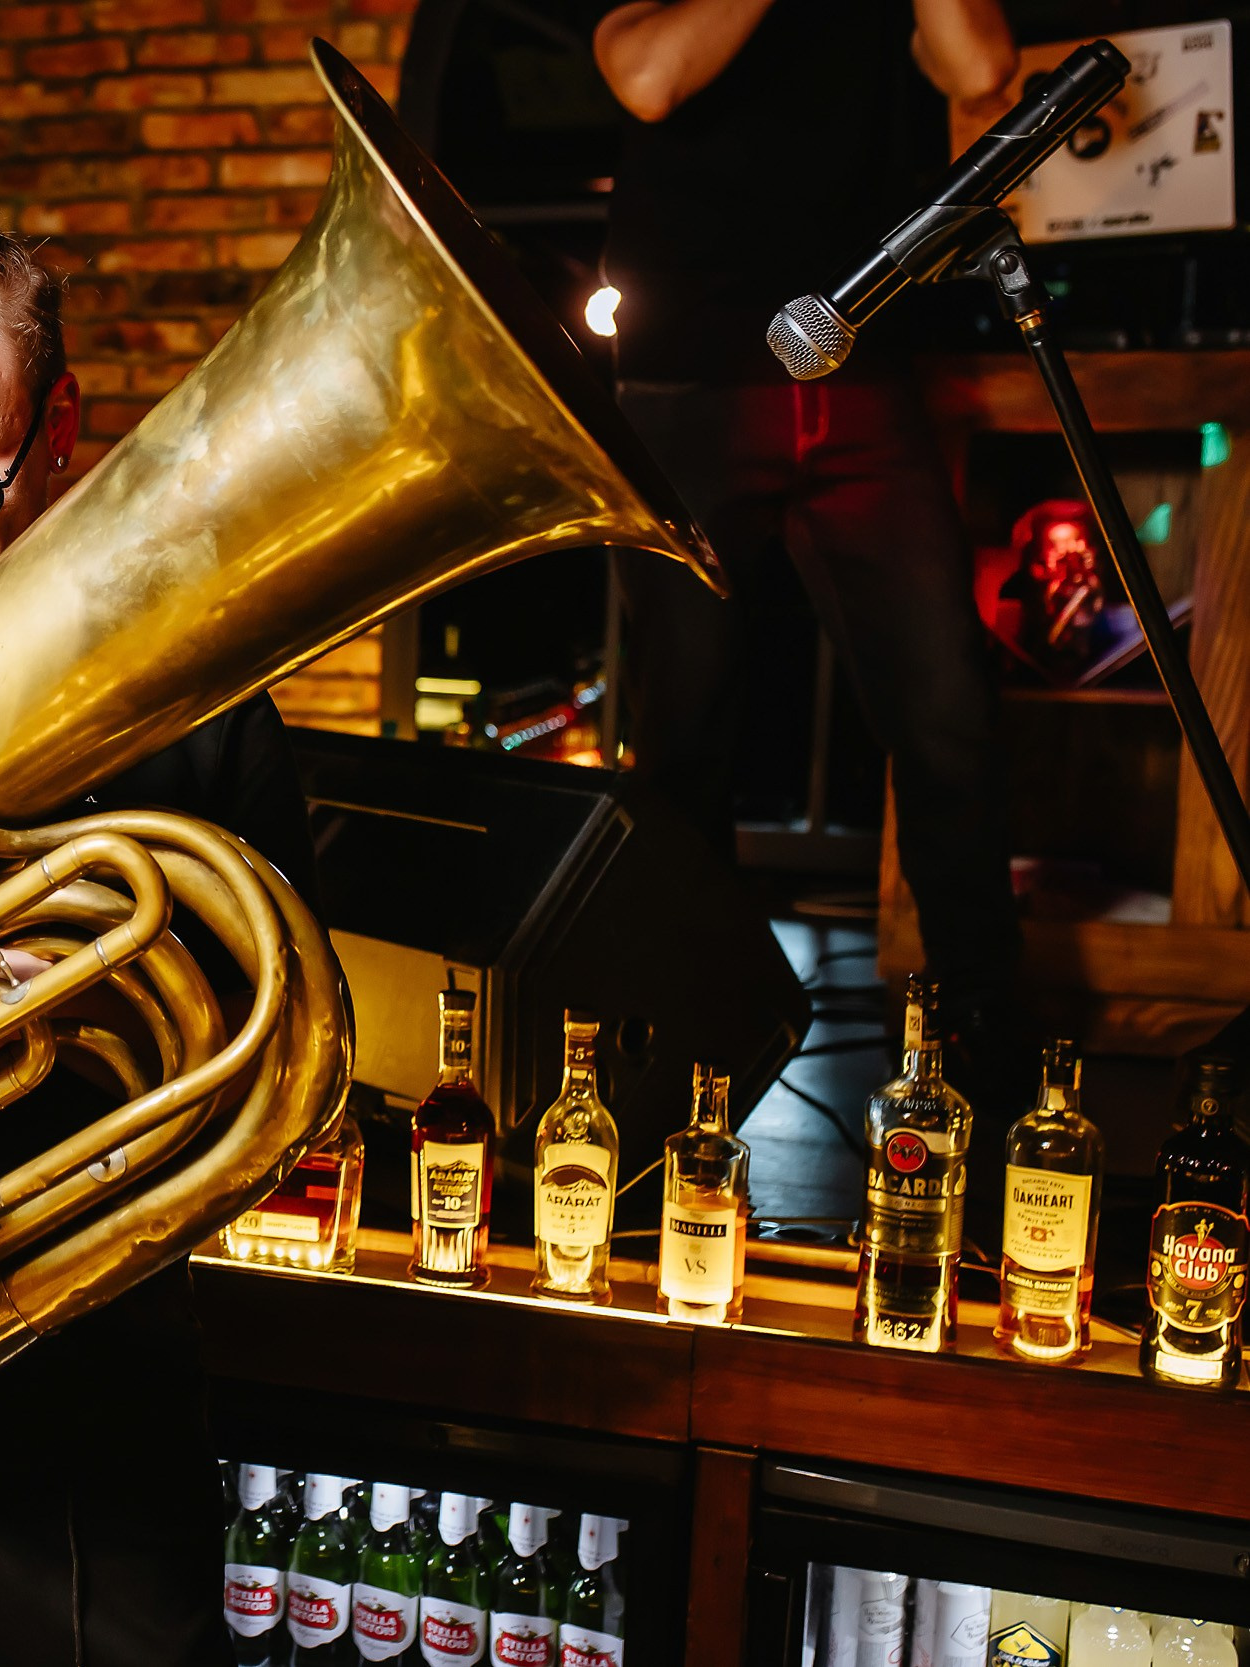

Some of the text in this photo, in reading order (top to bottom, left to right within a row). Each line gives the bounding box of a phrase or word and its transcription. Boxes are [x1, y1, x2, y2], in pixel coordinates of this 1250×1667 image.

[451, 1040, 465, 1053] 10
[575, 1047, 585, 1060] 5
[444, 1196, 461, 1211] 10
[546, 1192, 601, 1208] ARARAT
[1013, 1187, 1075, 1210] OAKHEART
[239, 1215, 259, 1230] 20
[671, 1219, 725, 1237] MARTELL
[1162, 1234, 1237, 1264] Havana
[684, 1257, 707, 1275] VS
[1174, 1259, 1219, 1283] Club
[1185, 1298, 1203, 1322] 7
[426, 1621, 470, 1639] STELLA
[502, 1636, 547, 1652] STELLA
[500, 1648, 548, 1663] ARTOIS
